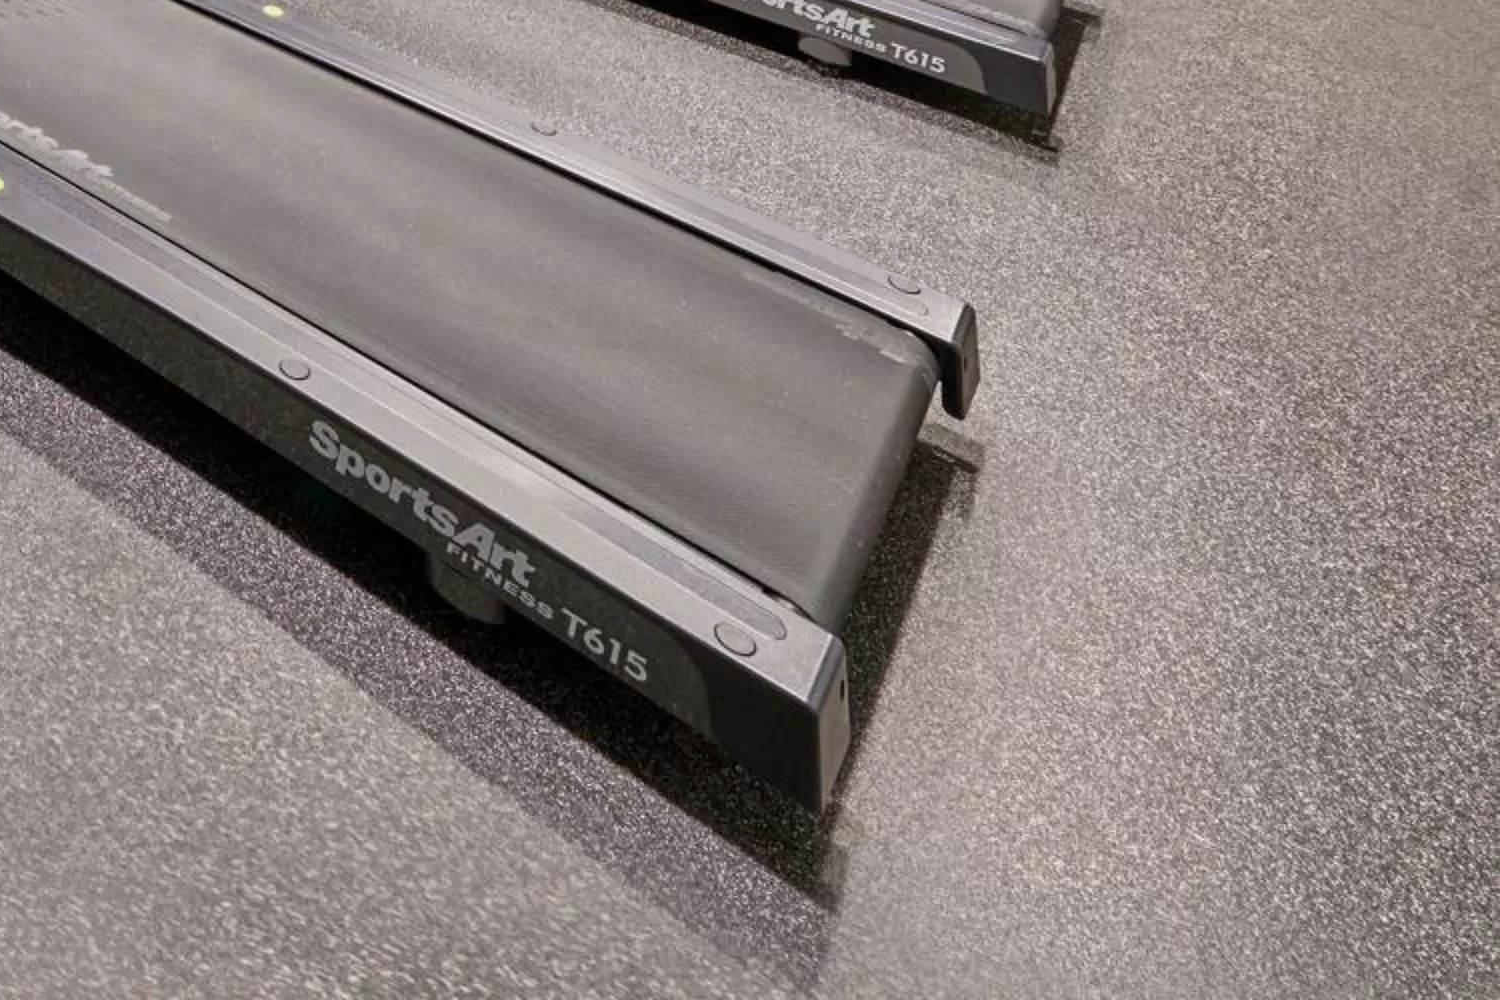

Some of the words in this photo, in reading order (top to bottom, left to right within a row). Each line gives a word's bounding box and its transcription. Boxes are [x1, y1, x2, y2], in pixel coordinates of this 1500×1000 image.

[815, 22, 888, 53] FITNESS
[891, 41, 946, 74] T615
[309, 419, 536, 589] SportsArt
[446, 541, 554, 620] FITNESS
[560, 607, 648, 683] T615
